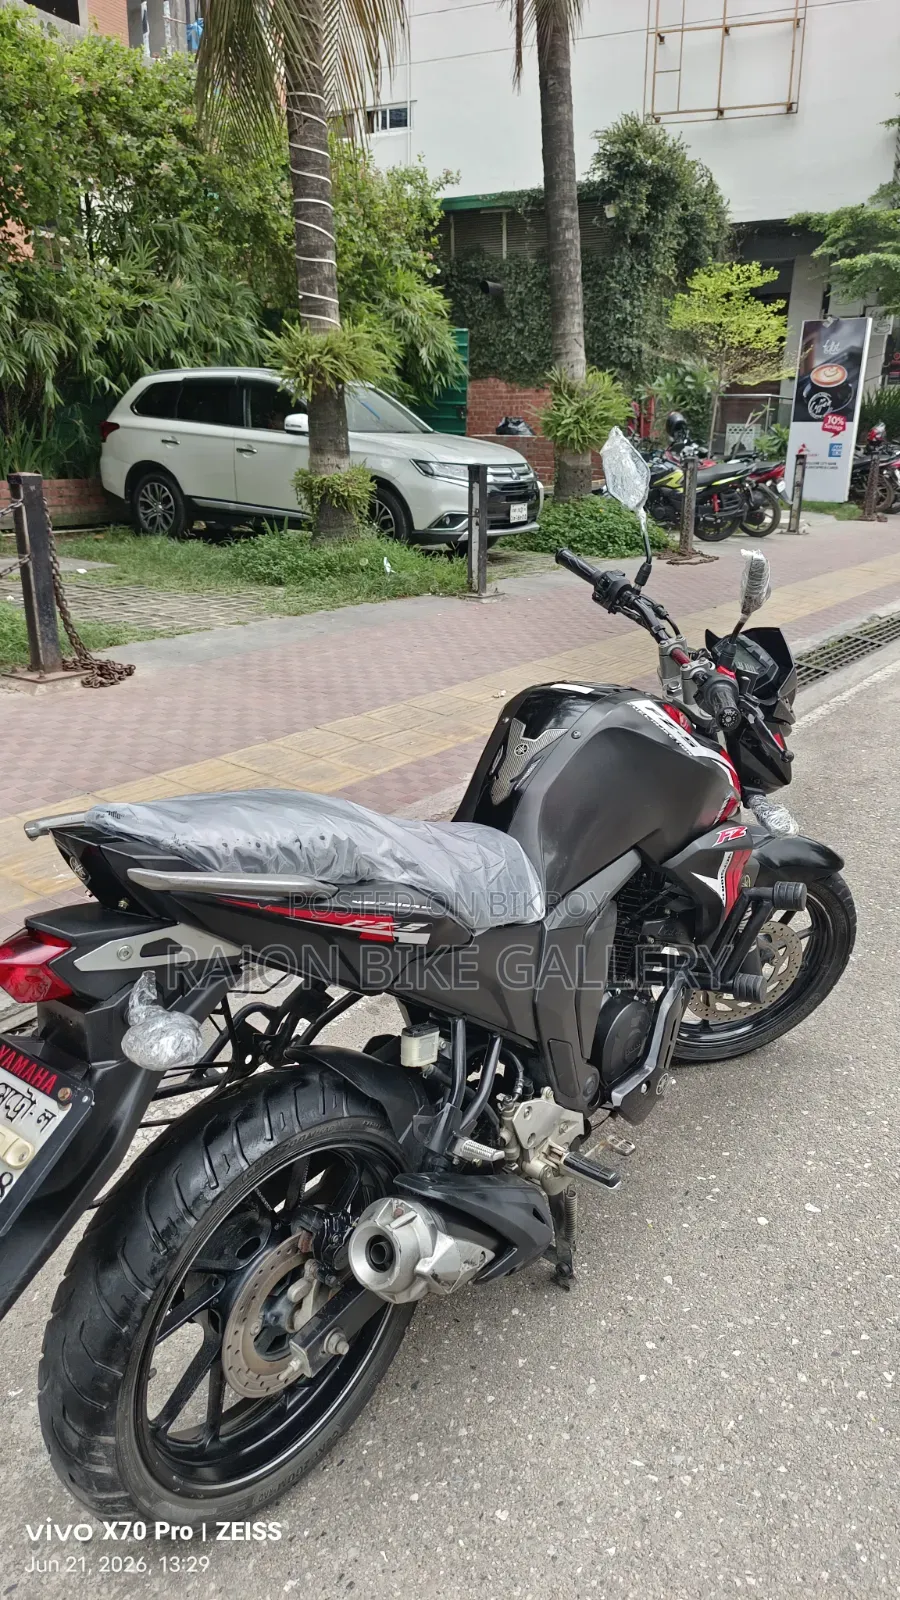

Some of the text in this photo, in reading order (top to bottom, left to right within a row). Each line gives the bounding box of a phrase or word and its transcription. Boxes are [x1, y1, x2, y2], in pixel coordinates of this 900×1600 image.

[827, 415, 845, 426] 10%
[711, 826, 748, 848] FZ
[0, 1044, 58, 1095] YAMAHA
